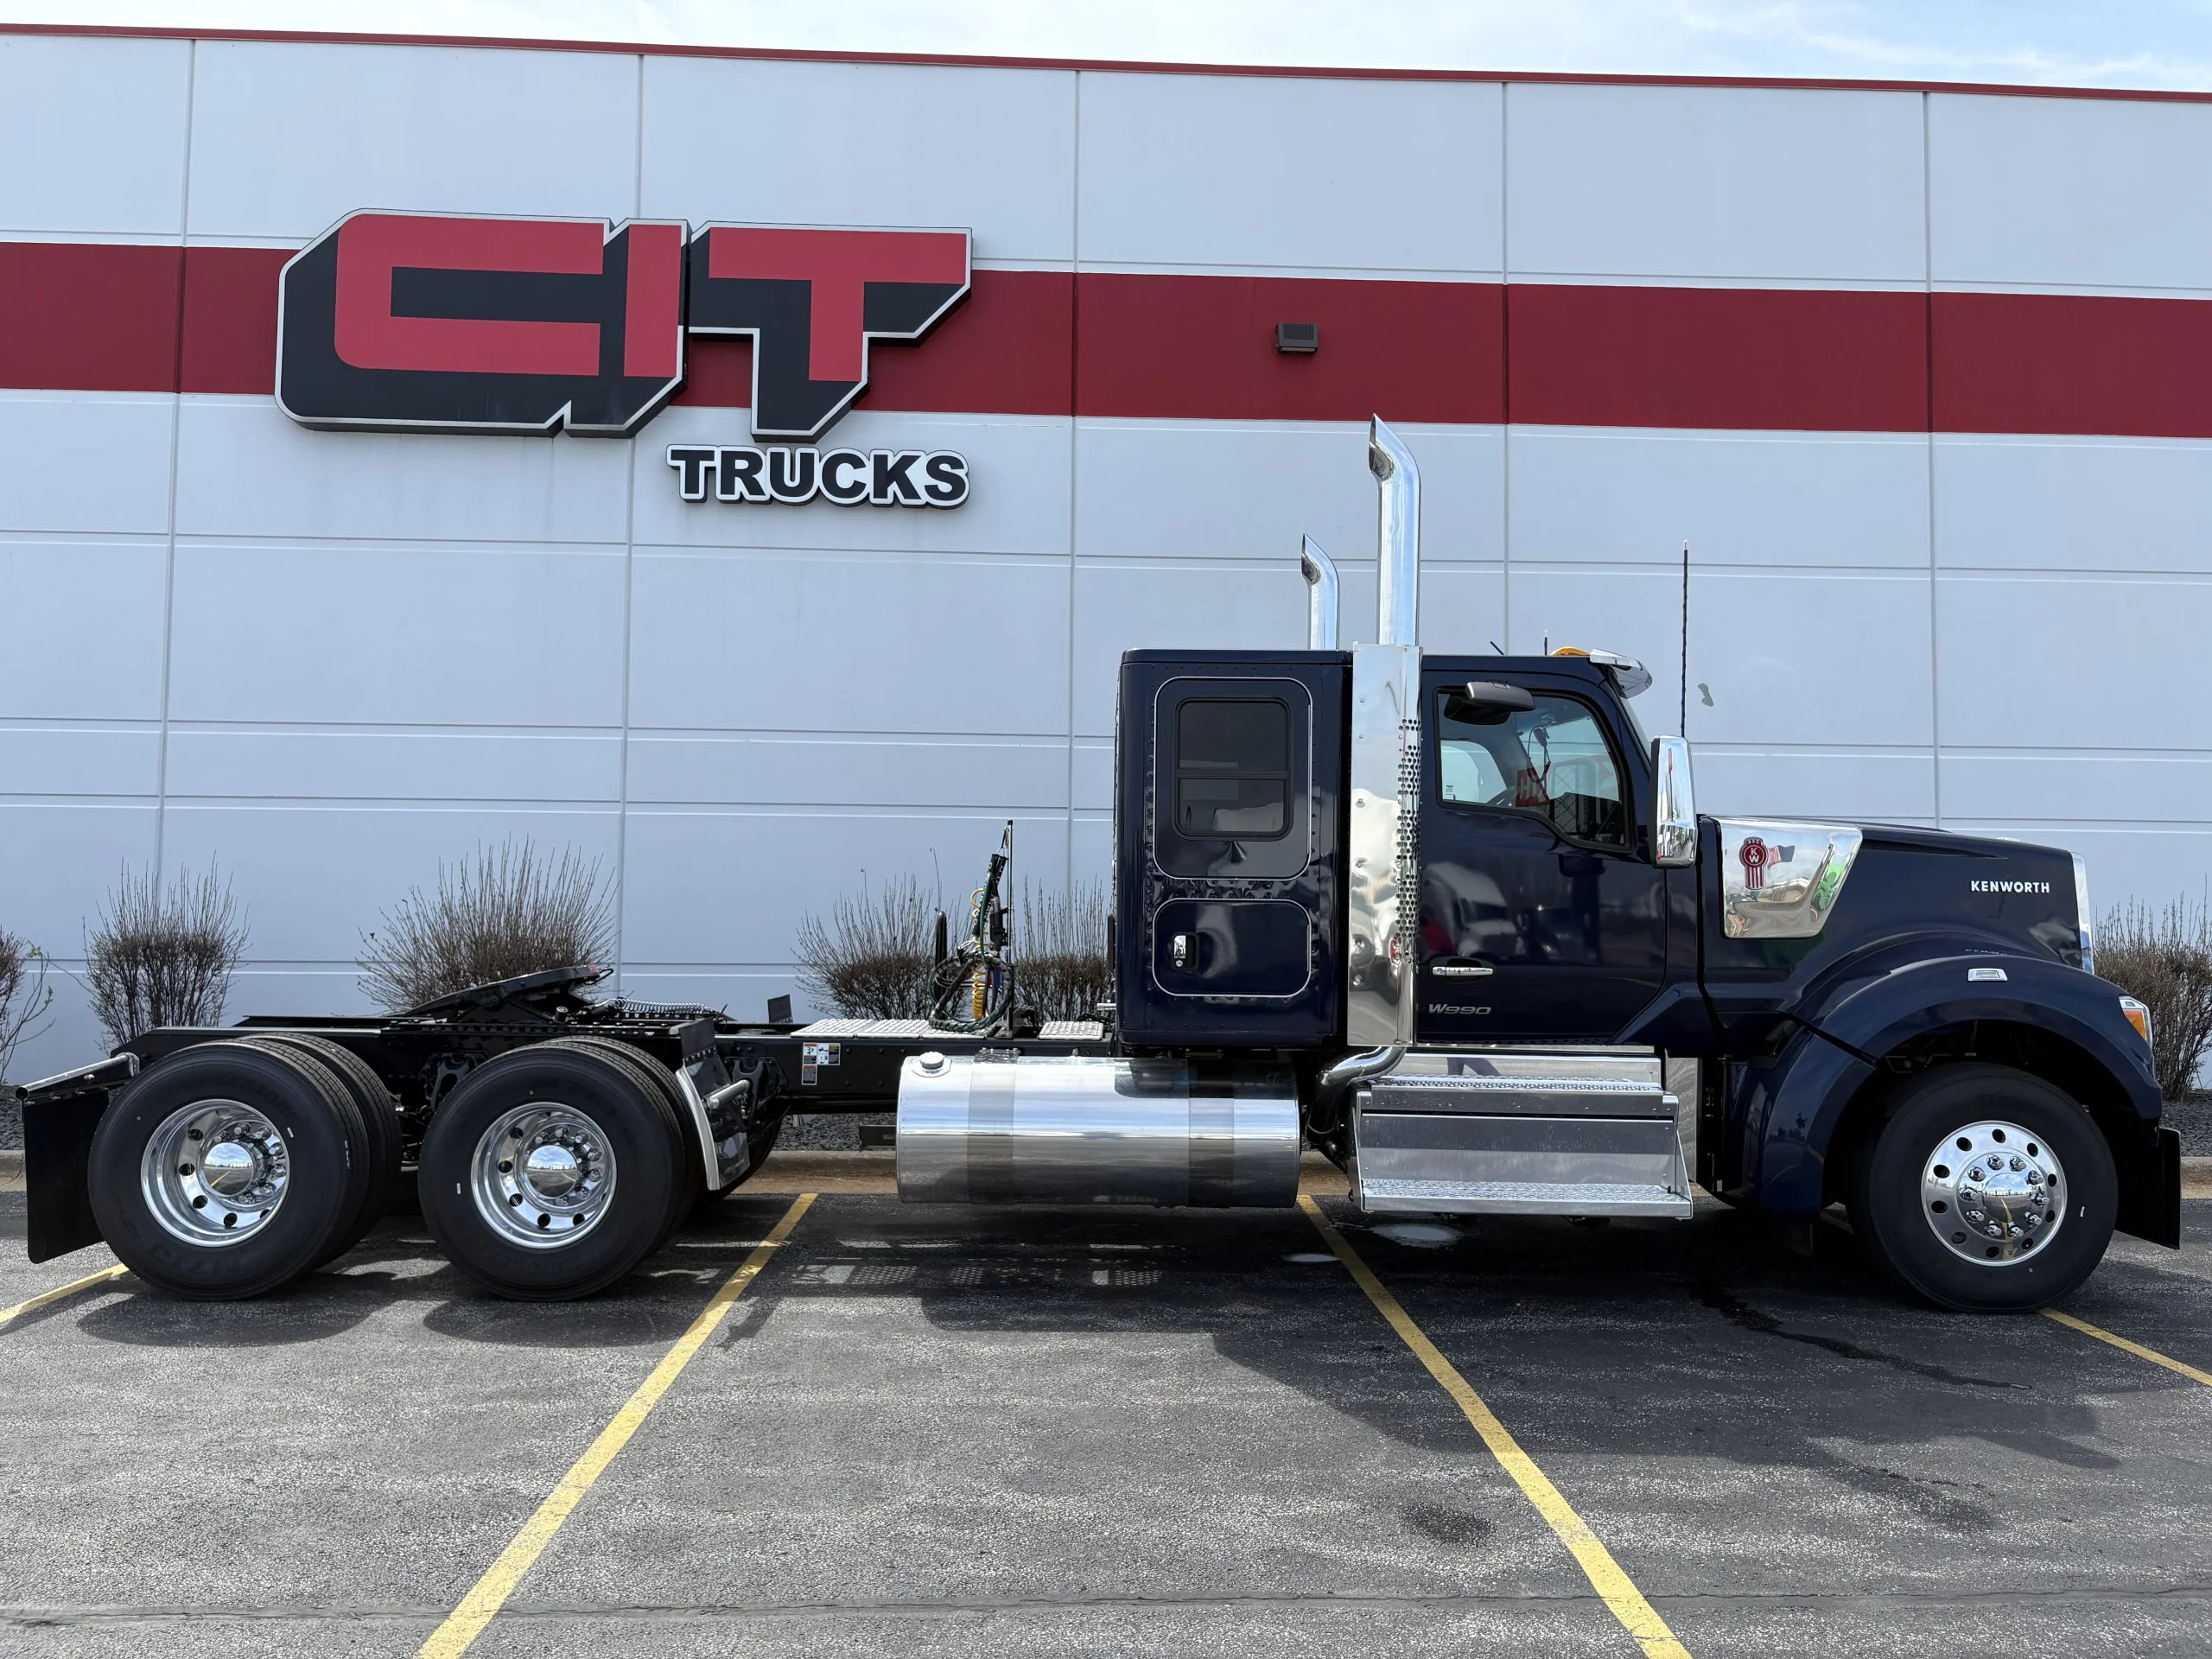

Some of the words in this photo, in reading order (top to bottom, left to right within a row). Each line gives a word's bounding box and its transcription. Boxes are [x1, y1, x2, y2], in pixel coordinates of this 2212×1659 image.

[302, 211, 969, 410] CIT
[670, 447, 967, 505] TRUCKS
[1970, 880, 2050, 893] KENWORTH
[1428, 1003, 1492, 1015] W990
